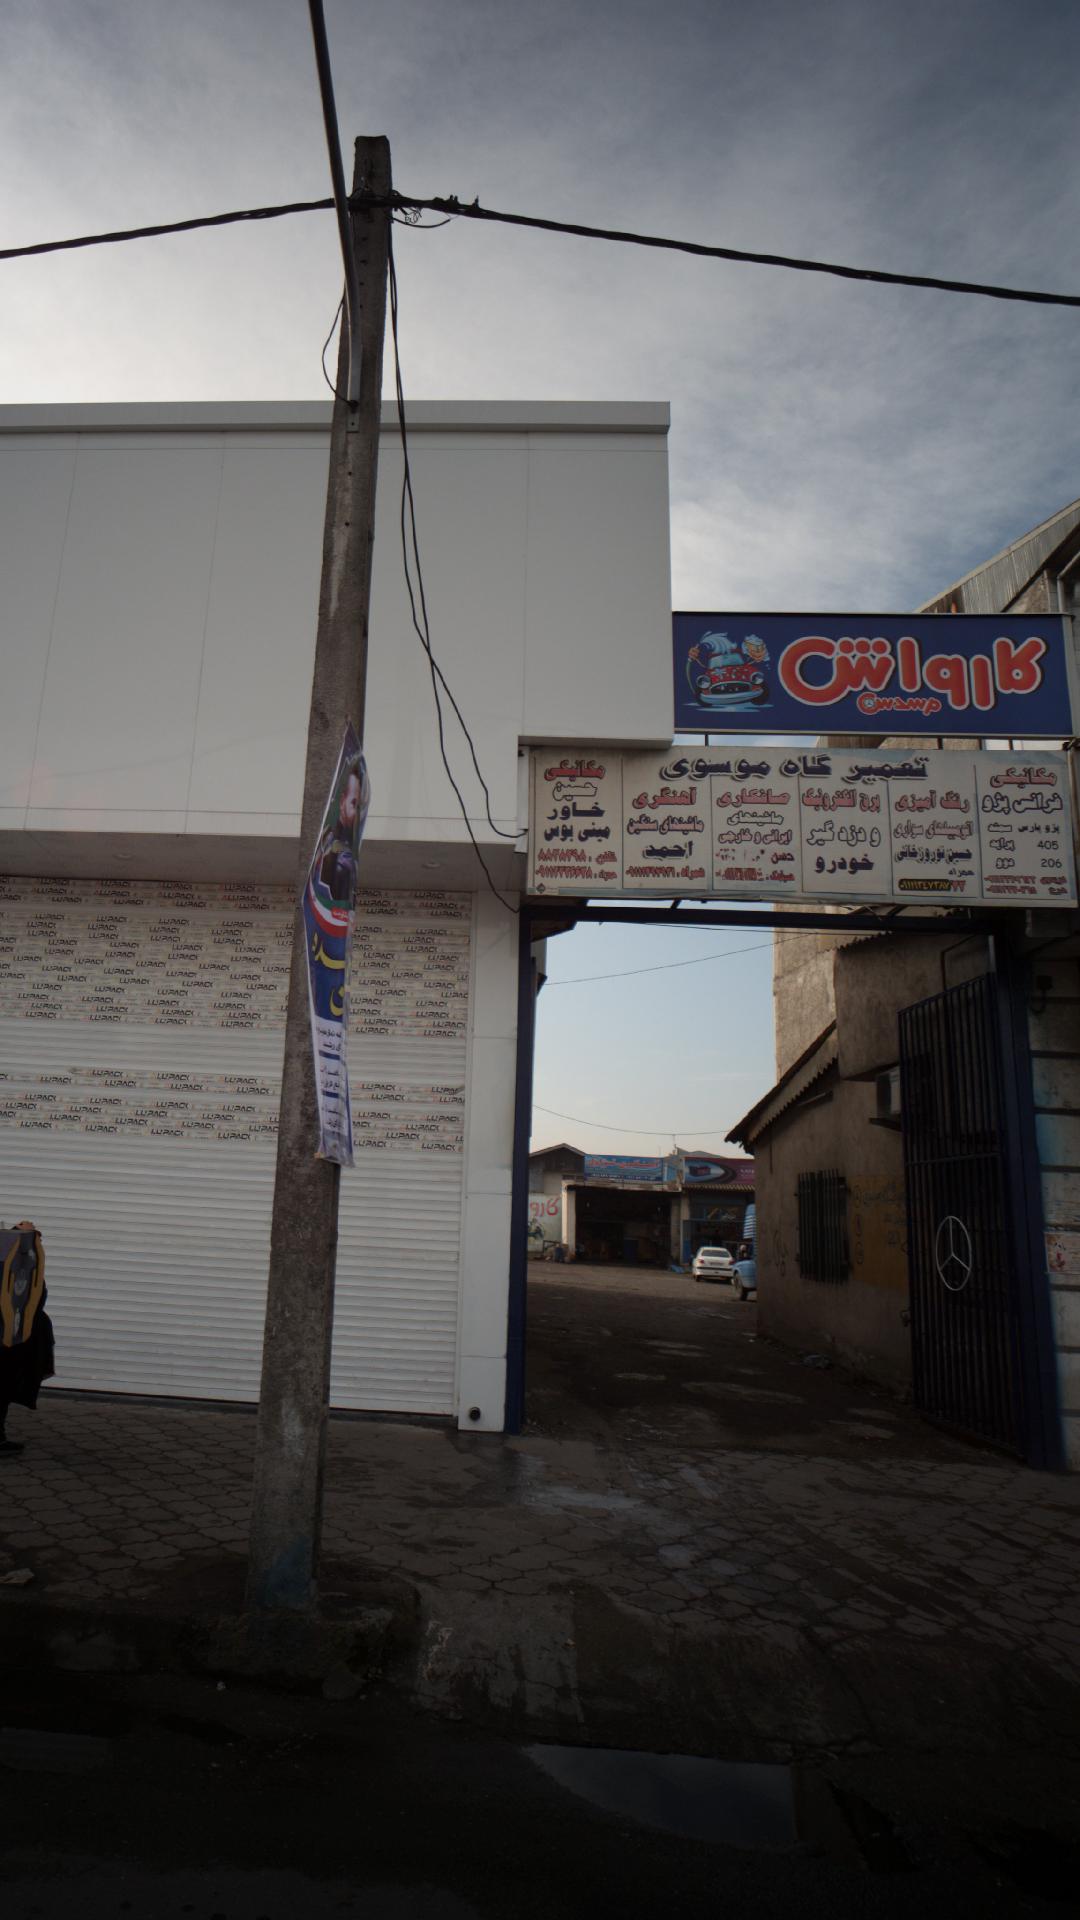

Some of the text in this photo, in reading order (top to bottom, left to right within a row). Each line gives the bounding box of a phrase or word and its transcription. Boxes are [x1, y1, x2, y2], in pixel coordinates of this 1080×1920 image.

[779, 636, 1045, 710] کارواش
[544, 759, 606, 782] مکانیکی
[990, 767, 1057, 788] مکانیکی
[553, 781, 598, 801] حسین
[632, 786, 697, 809] آهنگری
[717, 788, 791, 808] صافکاری
[547, 801, 605, 820] خاور
[544, 822, 610, 842] مینی بوس
[1037, 840, 1059, 850] 405
[815, 853, 874, 874] خودرو
[1041, 858, 1062, 868] 206
